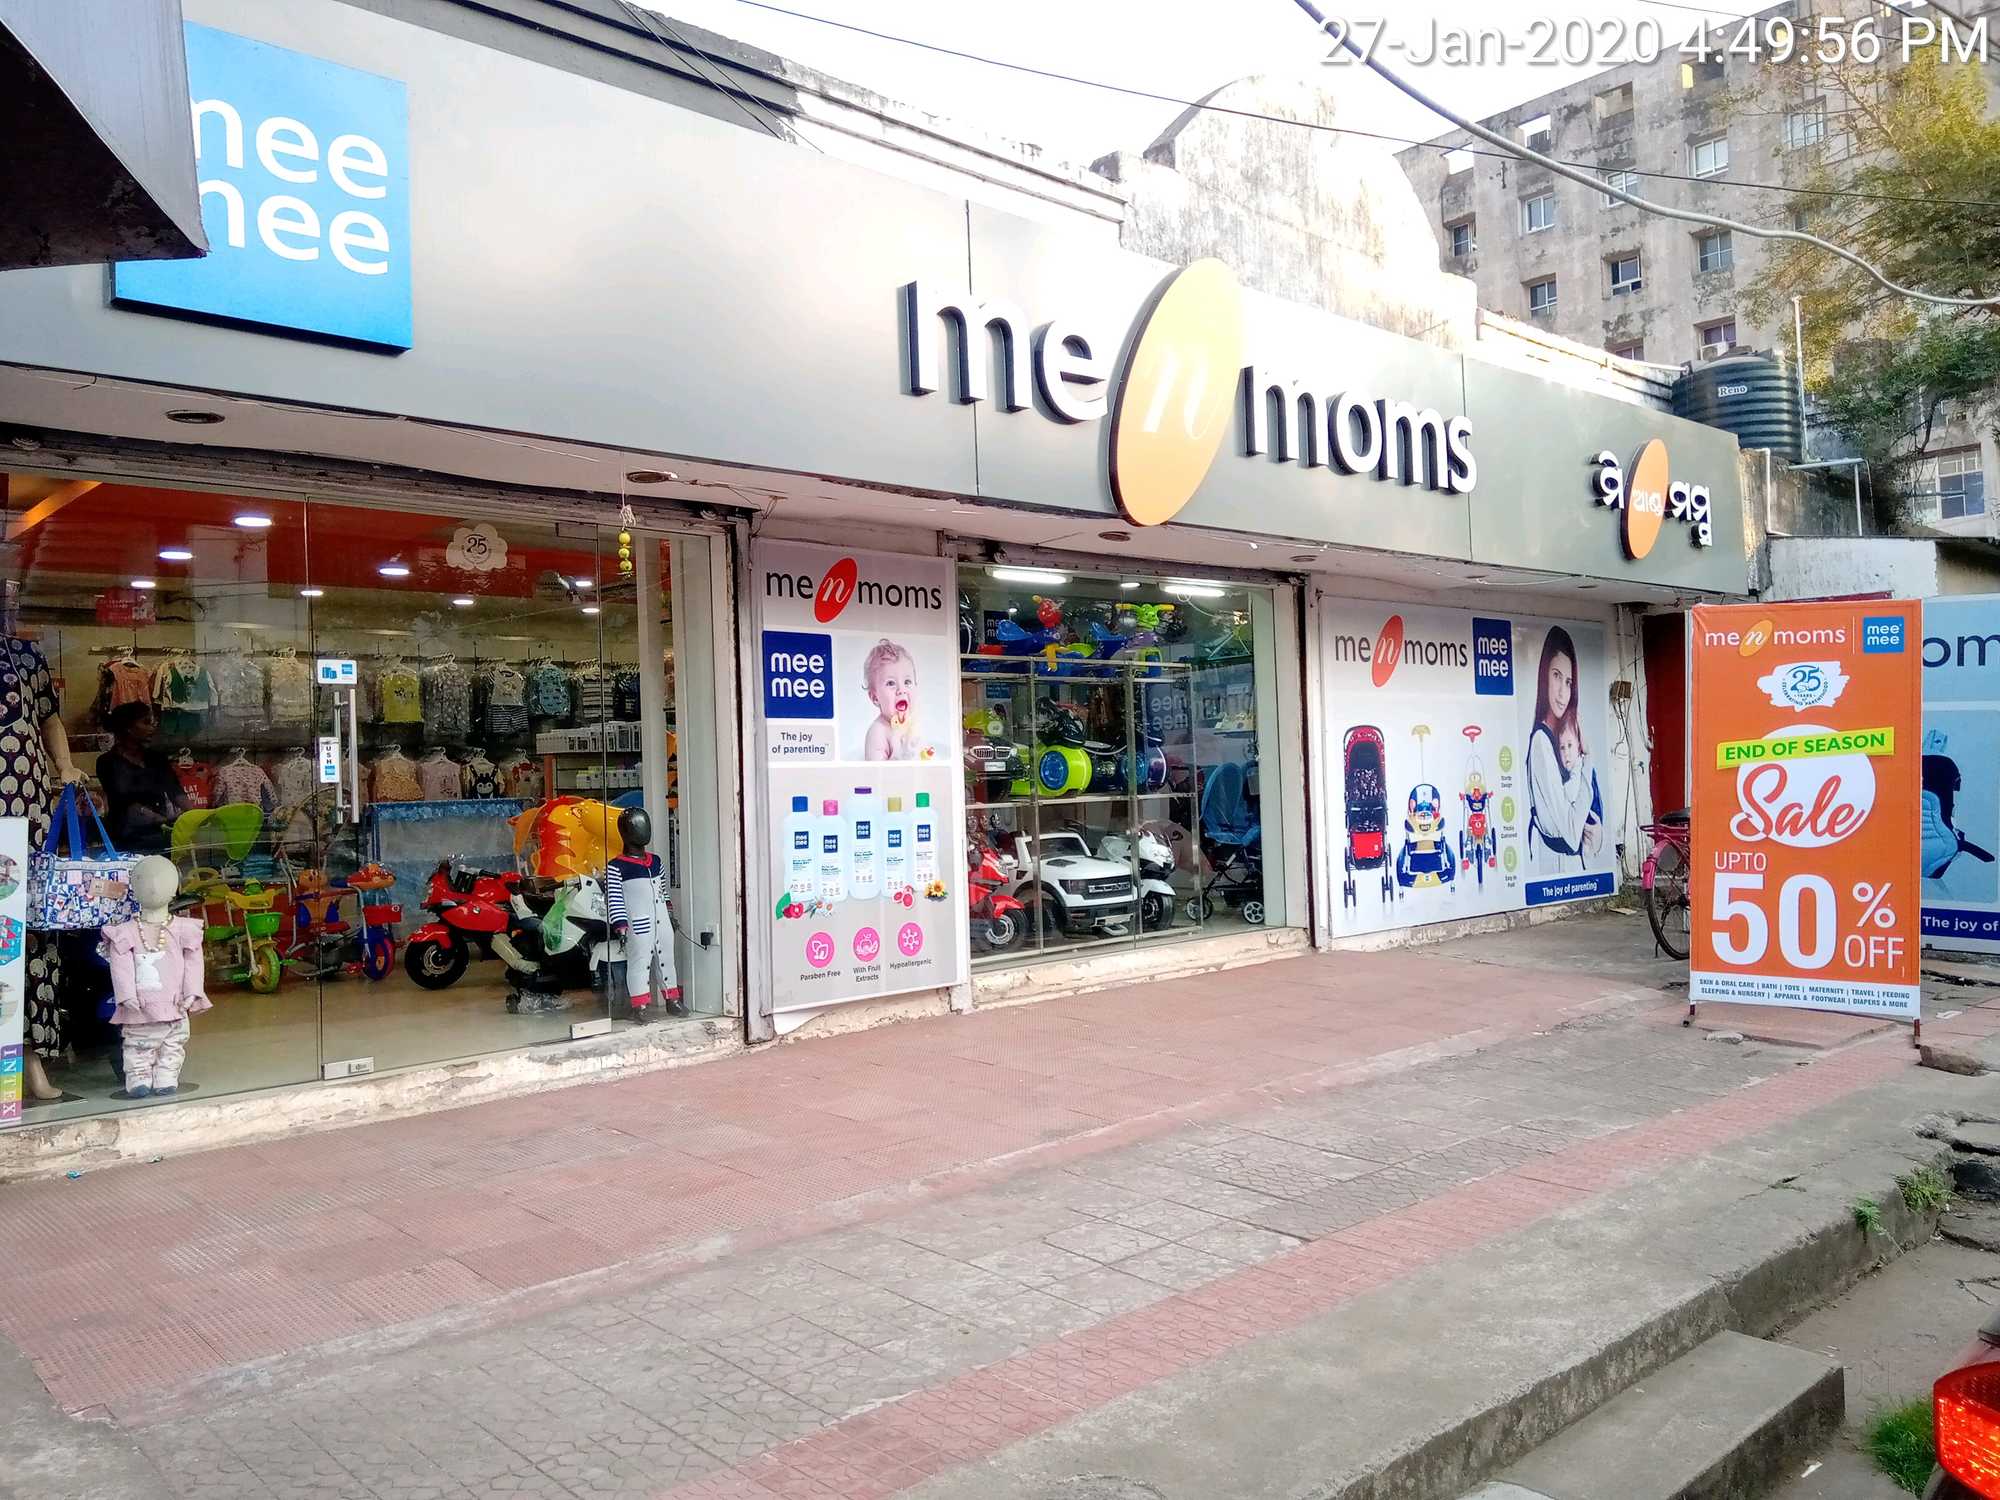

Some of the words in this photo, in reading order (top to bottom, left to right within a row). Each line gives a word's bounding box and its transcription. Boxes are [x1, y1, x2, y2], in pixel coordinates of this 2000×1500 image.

[906, 280, 1108, 424] me
[1244, 365, 1477, 493] moms
[1720, 386, 1746, 395] Reno
[467, 537, 487, 555] 25
[766, 571, 813, 599] me
[858, 580, 942, 610] moms
[1705, 631, 1740, 646] me
[1774, 629, 1845, 645] moms
[1867, 625, 1899, 635] mee
[1478, 637, 1508, 654] mee
[1867, 635, 1900, 645] mee
[1335, 635, 1371, 662] me
[1405, 639, 1468, 667] moms
[770, 652, 824, 674] mee
[1478, 659, 1509, 677] mee
[771, 677, 825, 698] mee
[1790, 667, 1821, 692] 25
[781, 732, 797, 741] The
[798, 732, 813, 745] joy
[1726, 745, 1765, 761] END
[1772, 741, 1798, 756] OF
[1804, 733, 1885, 753] SEASON
[772, 744, 781, 753] of
[783, 744, 826, 755] parenting
[1736, 763, 1865, 838] Sale
[1715, 851, 1767, 871] UPTO
[1542, 887, 1553, 896] The
[1554, 885, 1563, 896] joy
[1564, 883, 1570, 893] of
[1571, 881, 1597, 894] parenting
[1711, 872, 1837, 970] 50
[1922, 916, 1950, 928] The
[1954, 917, 1977, 932] joy
[1983, 921, 1999, 931] of
[1844, 935, 1904, 968] OFF
[800, 972, 826, 981] Paraben
[855, 973, 879, 982] Extracts
[1737, 990, 1765, 998] NURSERY
[1774, 993, 1801, 1001] APPAREL
[1811, 995, 1846, 1004] FOOTWEAR
[1853, 998, 1880, 1006] DIAPERS
[1808, 986, 1844, 994] MATERNITY
[1851, 989, 1875, 997] TRAVEL
[1882, 991, 1910, 999] FEEDING
